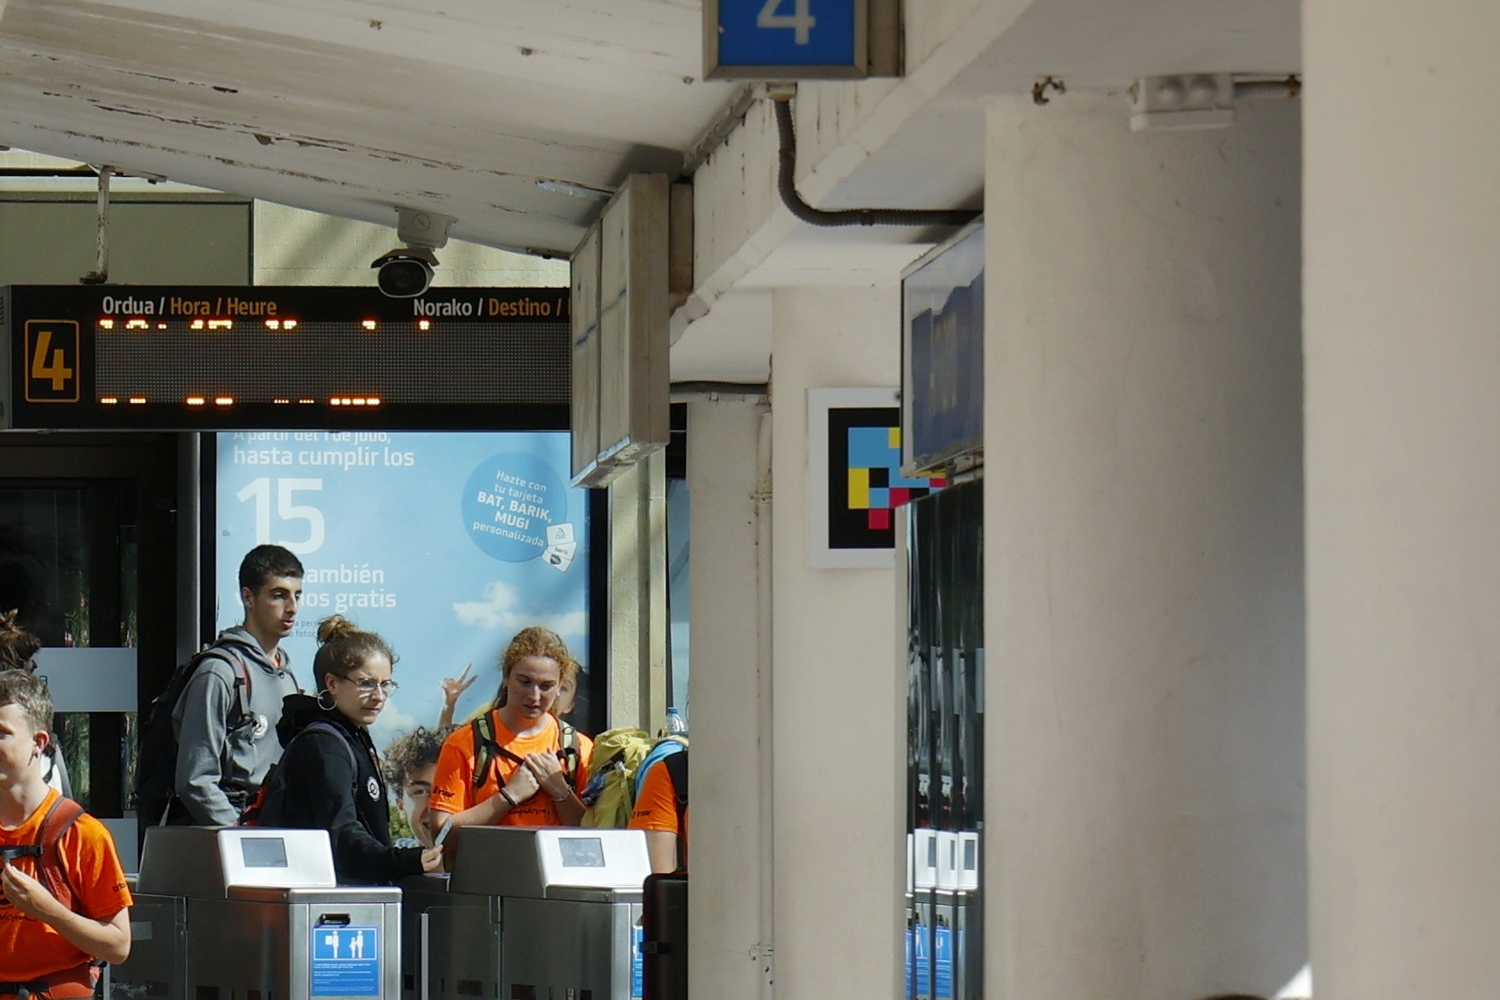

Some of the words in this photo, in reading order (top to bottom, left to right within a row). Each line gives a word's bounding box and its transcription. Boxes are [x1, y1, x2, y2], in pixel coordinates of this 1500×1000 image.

[756, 0, 816, 46] 4
[102, 295, 155, 315] Ordua
[158, 296, 165, 315] /
[170, 297, 211, 316] Hora
[215, 297, 222, 316] /
[227, 297, 277, 316] Heure
[413, 298, 473, 317] Norako
[477, 298, 484, 317] /
[489, 297, 551, 317] Destino
[556, 298, 563, 317] /
[31, 330, 73, 391] 4
[248, 431, 289, 444] partir
[294, 431, 318, 441] del
[332, 431, 351, 442] de
[233, 445, 293, 466] hasta
[298, 446, 380, 471] cumplir
[383, 446, 416, 467] los
[494, 483, 506, 494] tu
[508, 486, 544, 505] tarjeta
[496, 470, 527, 487] Hazte
[528, 481, 547, 493] con
[236, 477, 326, 555] 15
[476, 490, 505, 510] BAT,
[509, 500, 553, 523] BARIK,
[494, 510, 530, 530] MUGI
[472, 521, 545, 547] personalizada
[334, 588, 397, 614] gratis
